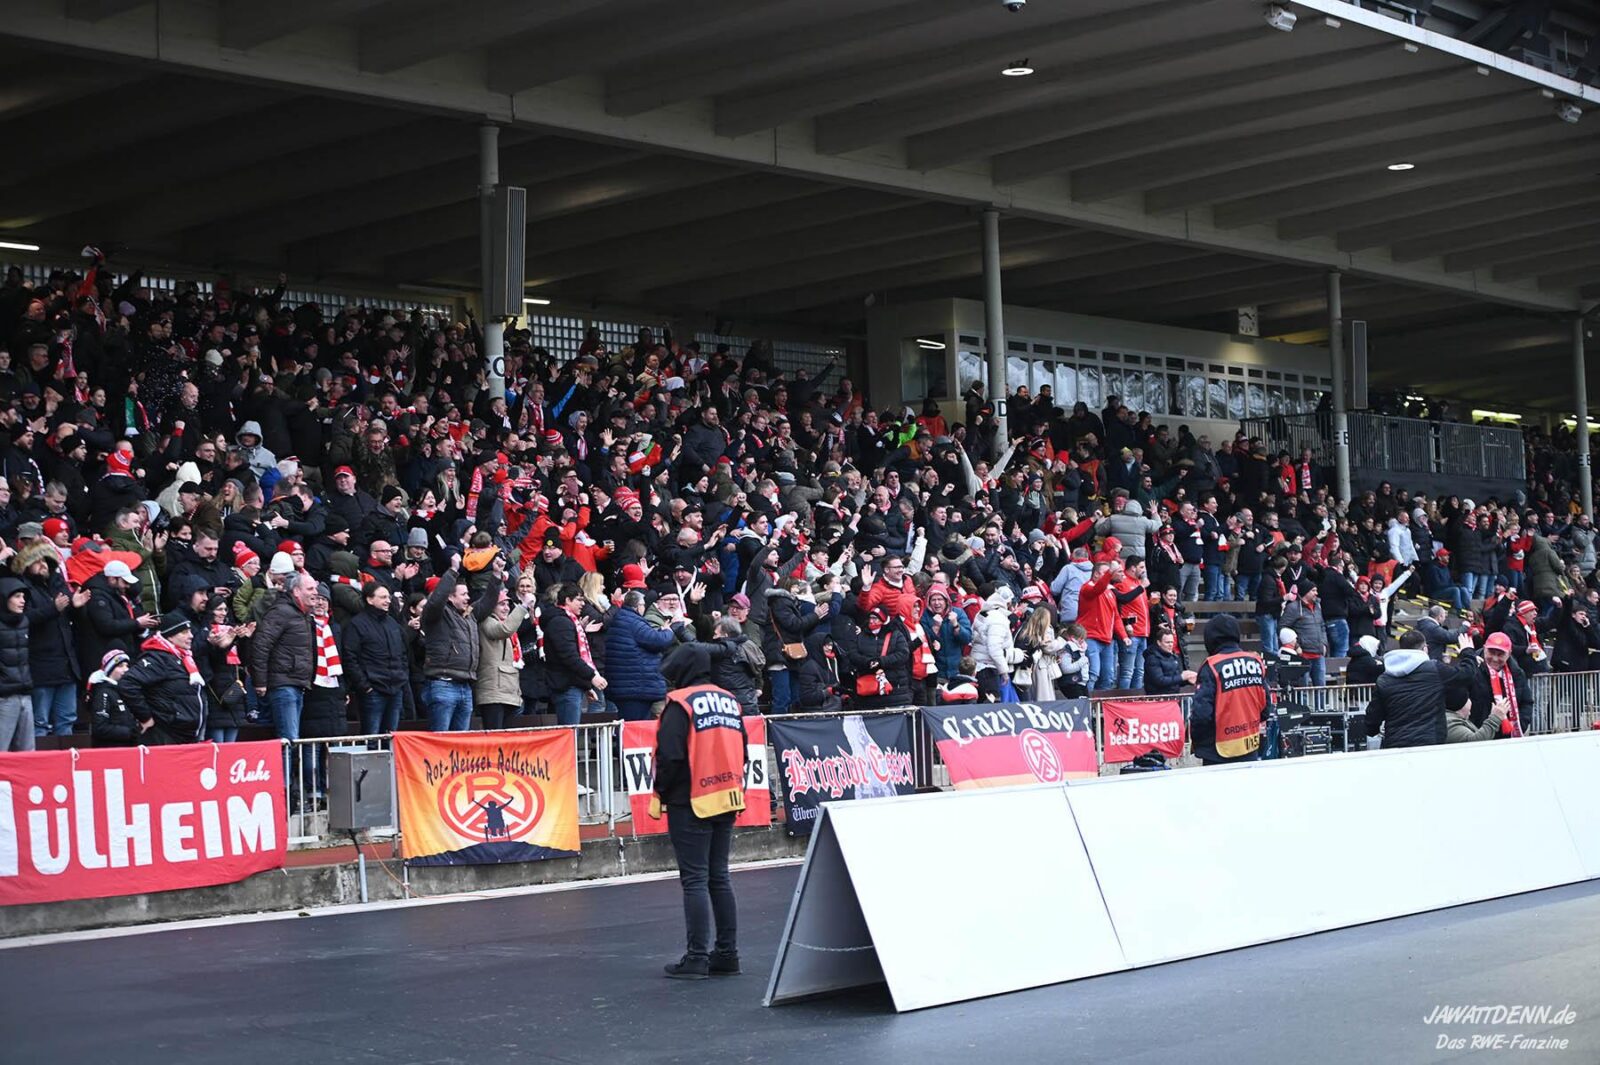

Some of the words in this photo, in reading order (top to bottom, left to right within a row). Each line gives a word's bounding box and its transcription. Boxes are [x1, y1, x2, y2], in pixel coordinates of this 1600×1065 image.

[1222, 659, 1262, 679] atlas
[1225, 677, 1247, 689] SAFETY
[1248, 676, 1263, 685] SHOE
[692, 692, 740, 716] atlas
[1224, 723, 1249, 736] ORDNE
[497, 747, 551, 781] Rollstuhl
[782, 745, 869, 802] Brigade
